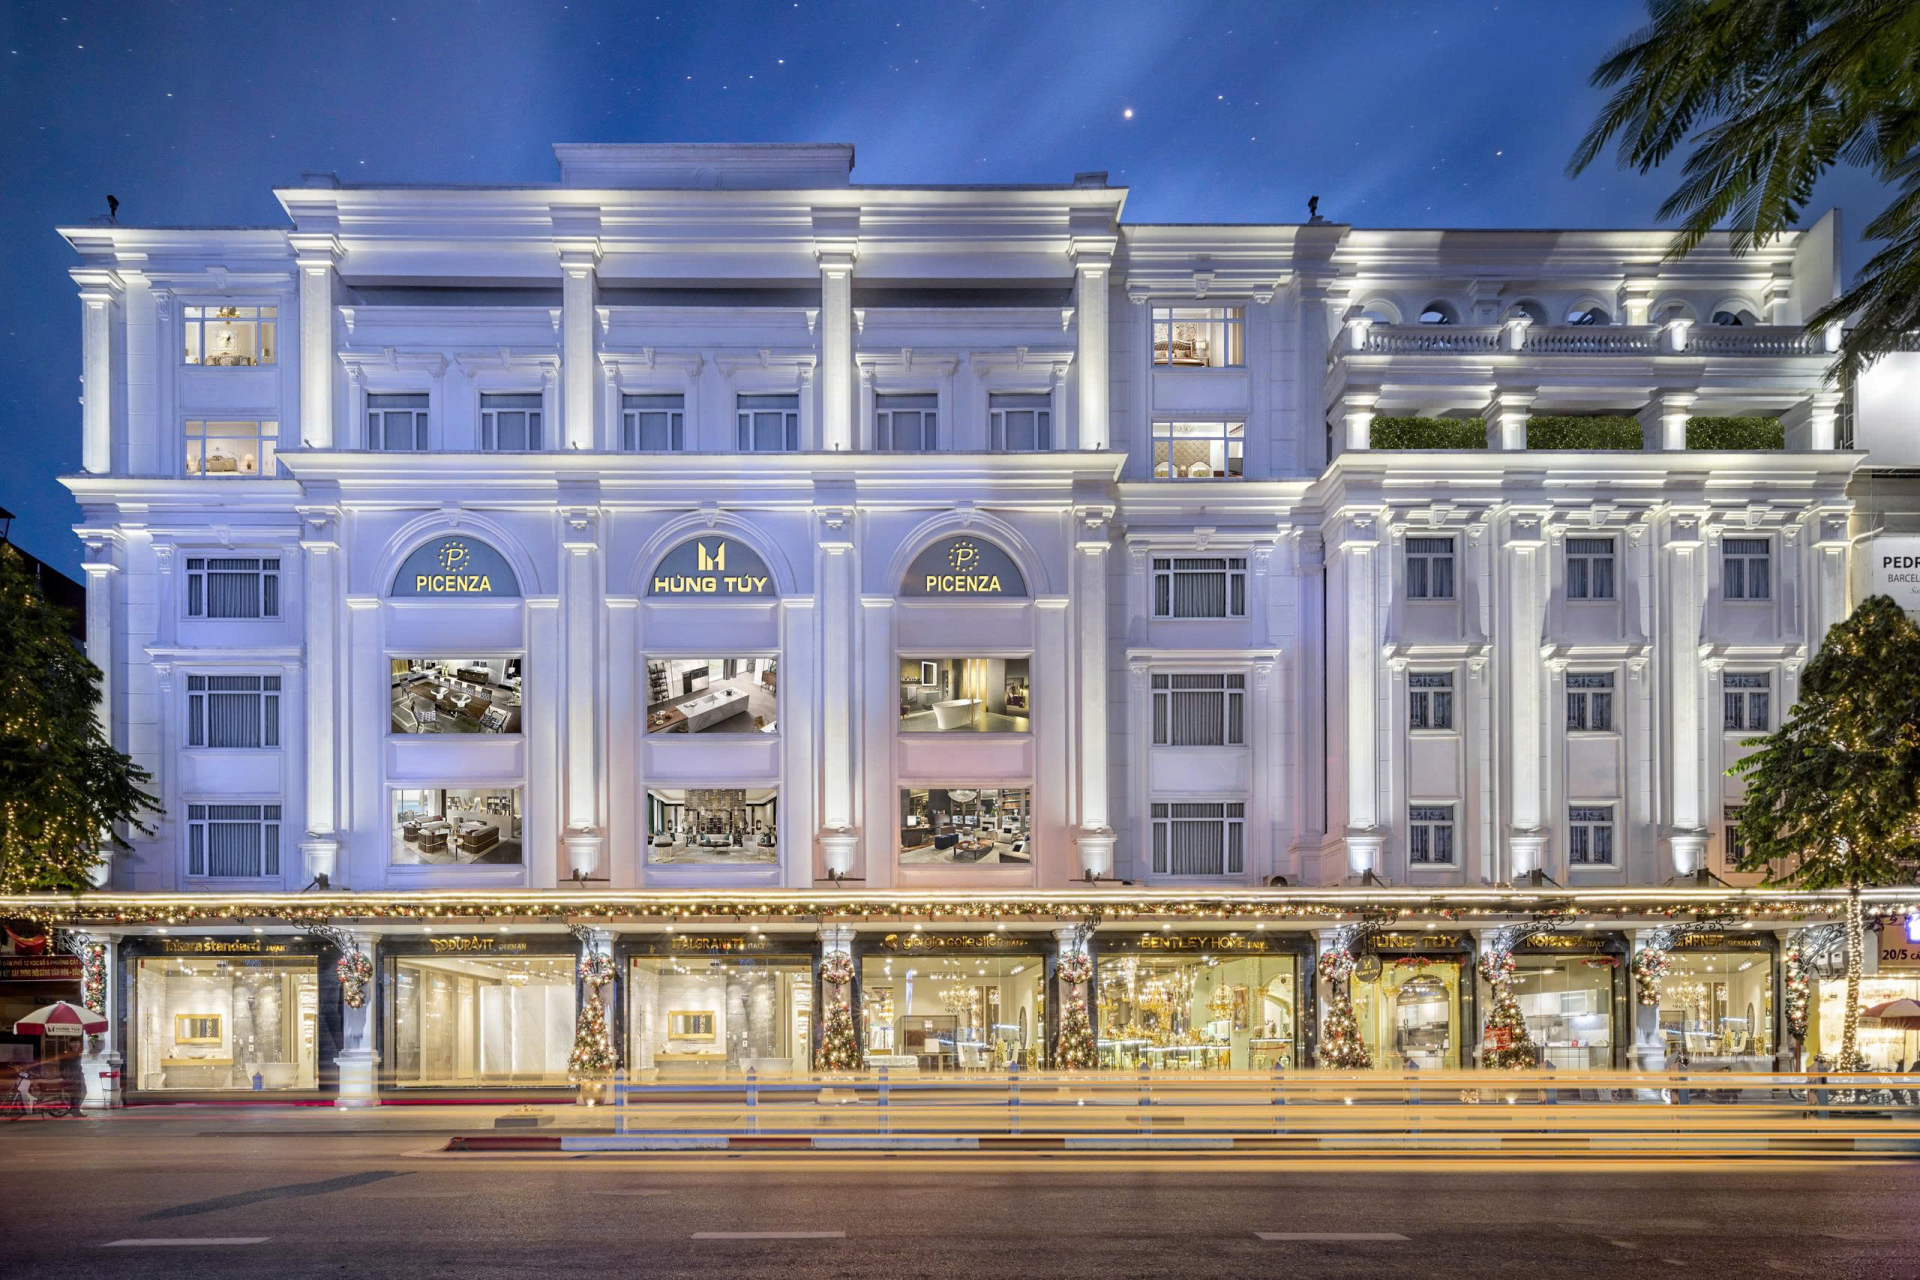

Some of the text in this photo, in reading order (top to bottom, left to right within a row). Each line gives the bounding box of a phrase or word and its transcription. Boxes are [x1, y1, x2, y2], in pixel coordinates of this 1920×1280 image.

[416, 575, 492, 592] PICENZA
[654, 573, 768, 592] HÙNG TÚY
[926, 575, 1002, 592] PICENZA
[161, 939, 203, 952] Takara
[203, 939, 261, 952] standard
[448, 935, 494, 951] DURAVIT
[946, 935, 1002, 948] collection
[1141, 936, 1208, 949] BENTLEY
[1211, 936, 1246, 949] HOME
[1422, 934, 1460, 948] TÚY
[1882, 949, 1908, 960] 20/5
